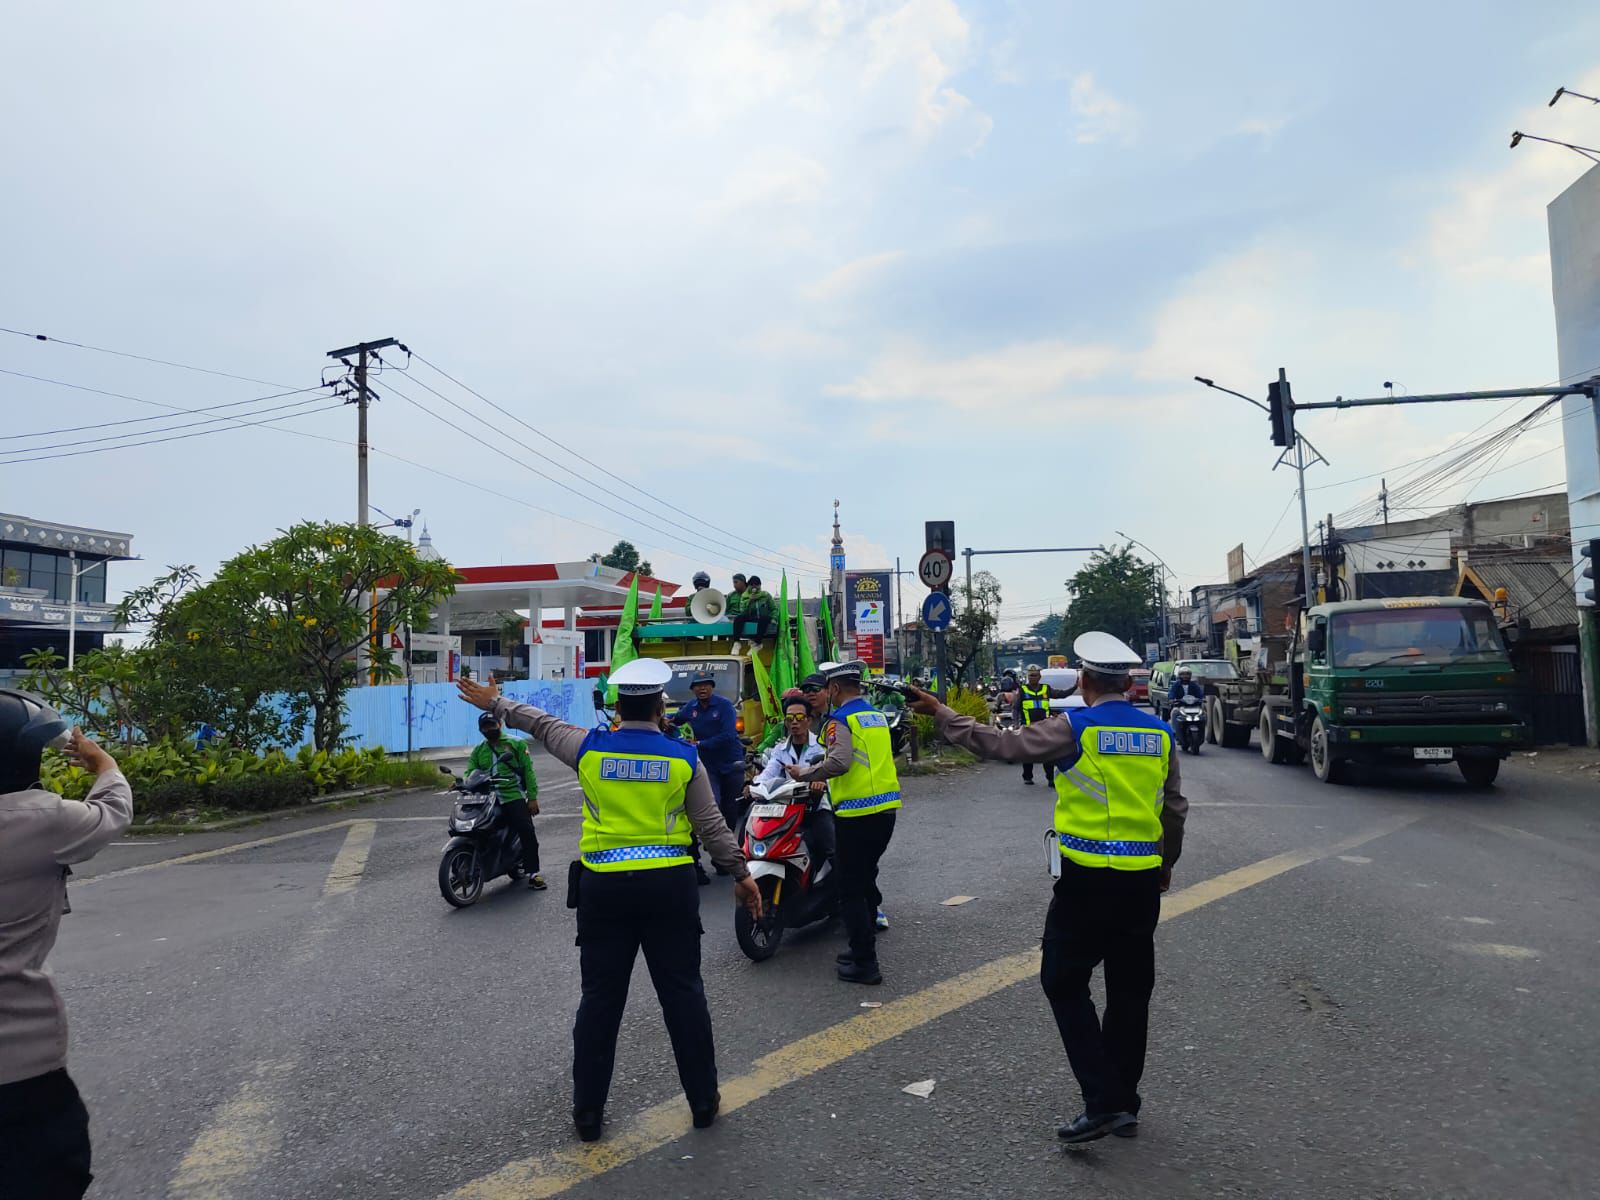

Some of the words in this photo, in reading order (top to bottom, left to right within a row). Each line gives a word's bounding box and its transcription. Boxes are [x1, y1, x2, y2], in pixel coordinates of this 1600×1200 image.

[923, 560, 942, 579] 40
[705, 662, 729, 671] Trans
[1100, 731, 1161, 754] POLISI
[602, 759, 669, 780] POLISI
